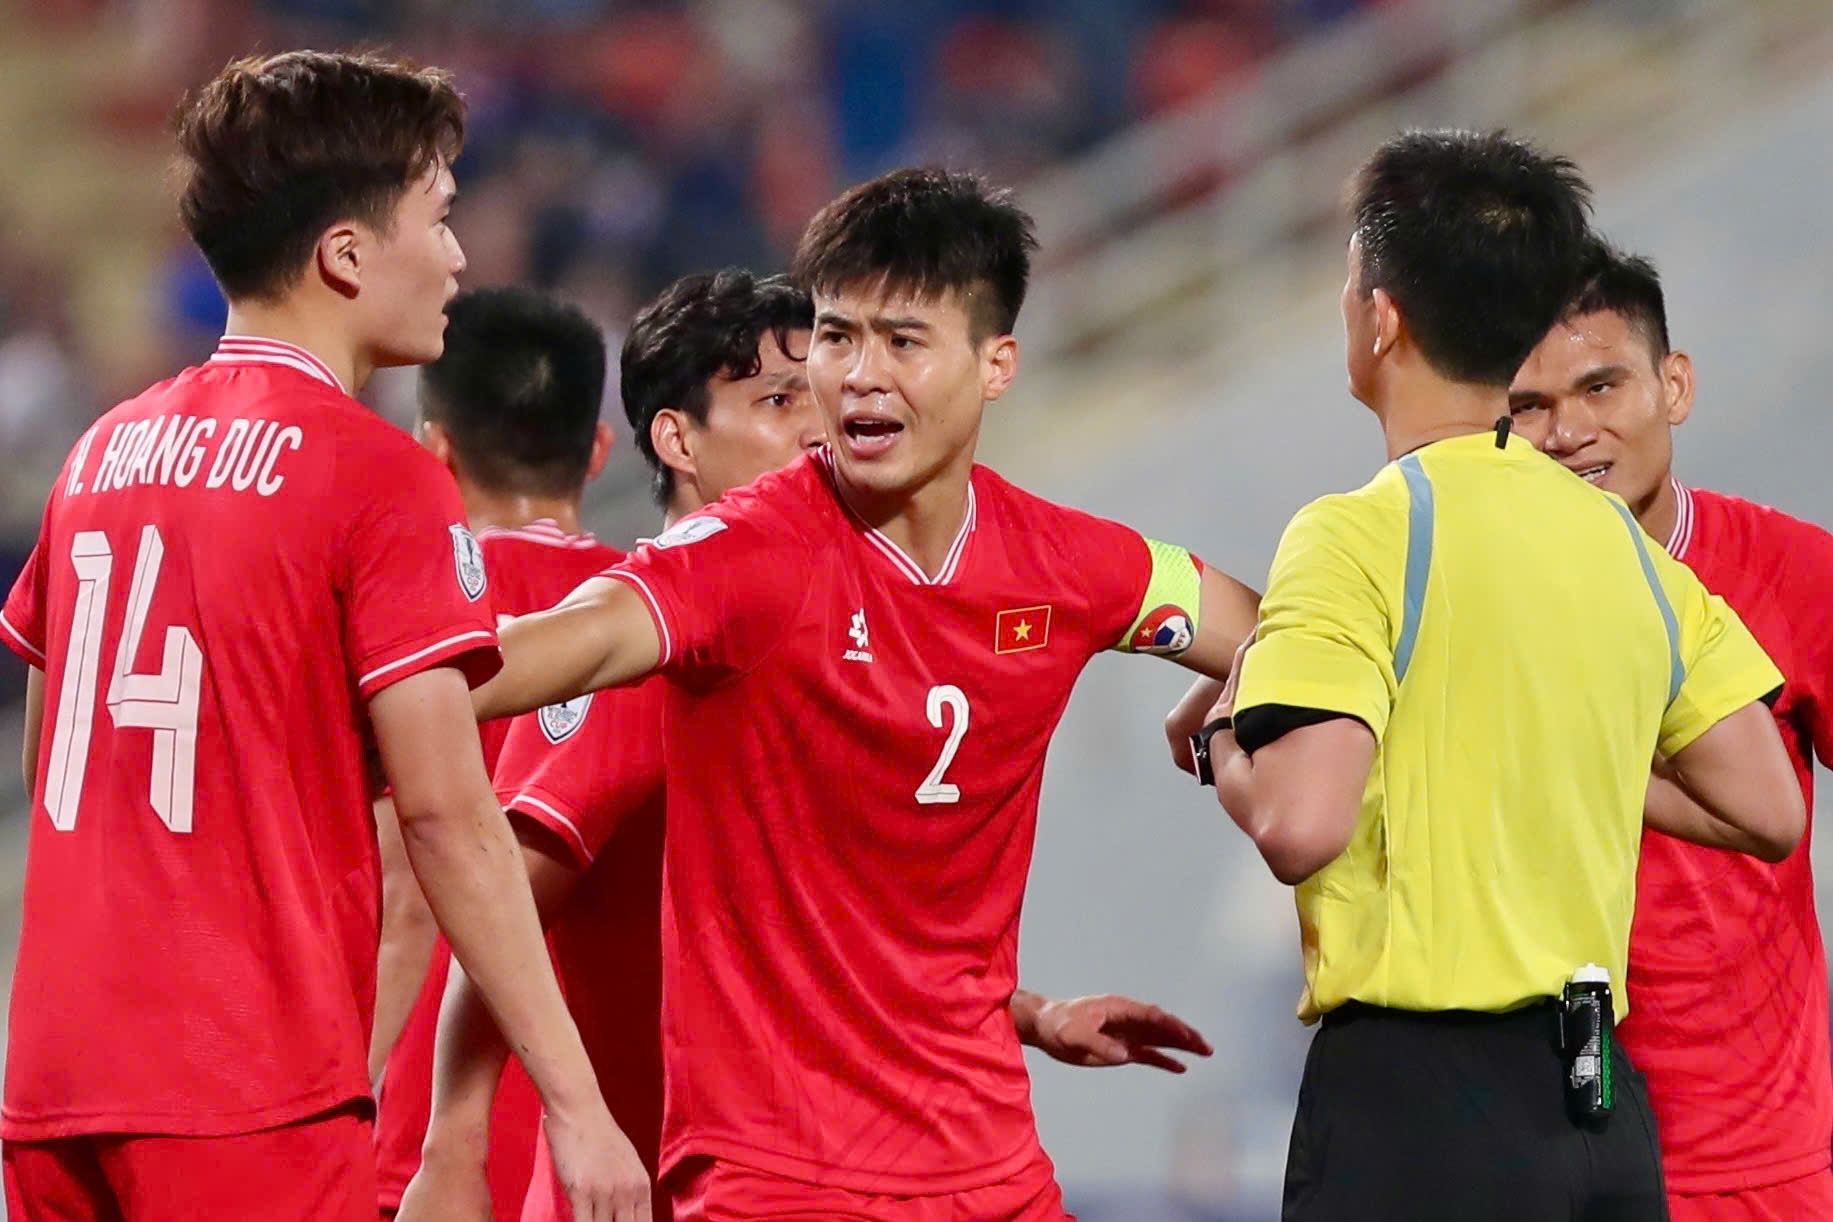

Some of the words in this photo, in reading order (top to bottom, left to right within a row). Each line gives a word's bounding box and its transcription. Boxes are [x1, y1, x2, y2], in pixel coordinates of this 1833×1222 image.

[91, 414, 217, 494] HOANG
[205, 418, 303, 497] DUC
[44, 524, 204, 834] 14
[914, 684, 970, 805] 2
